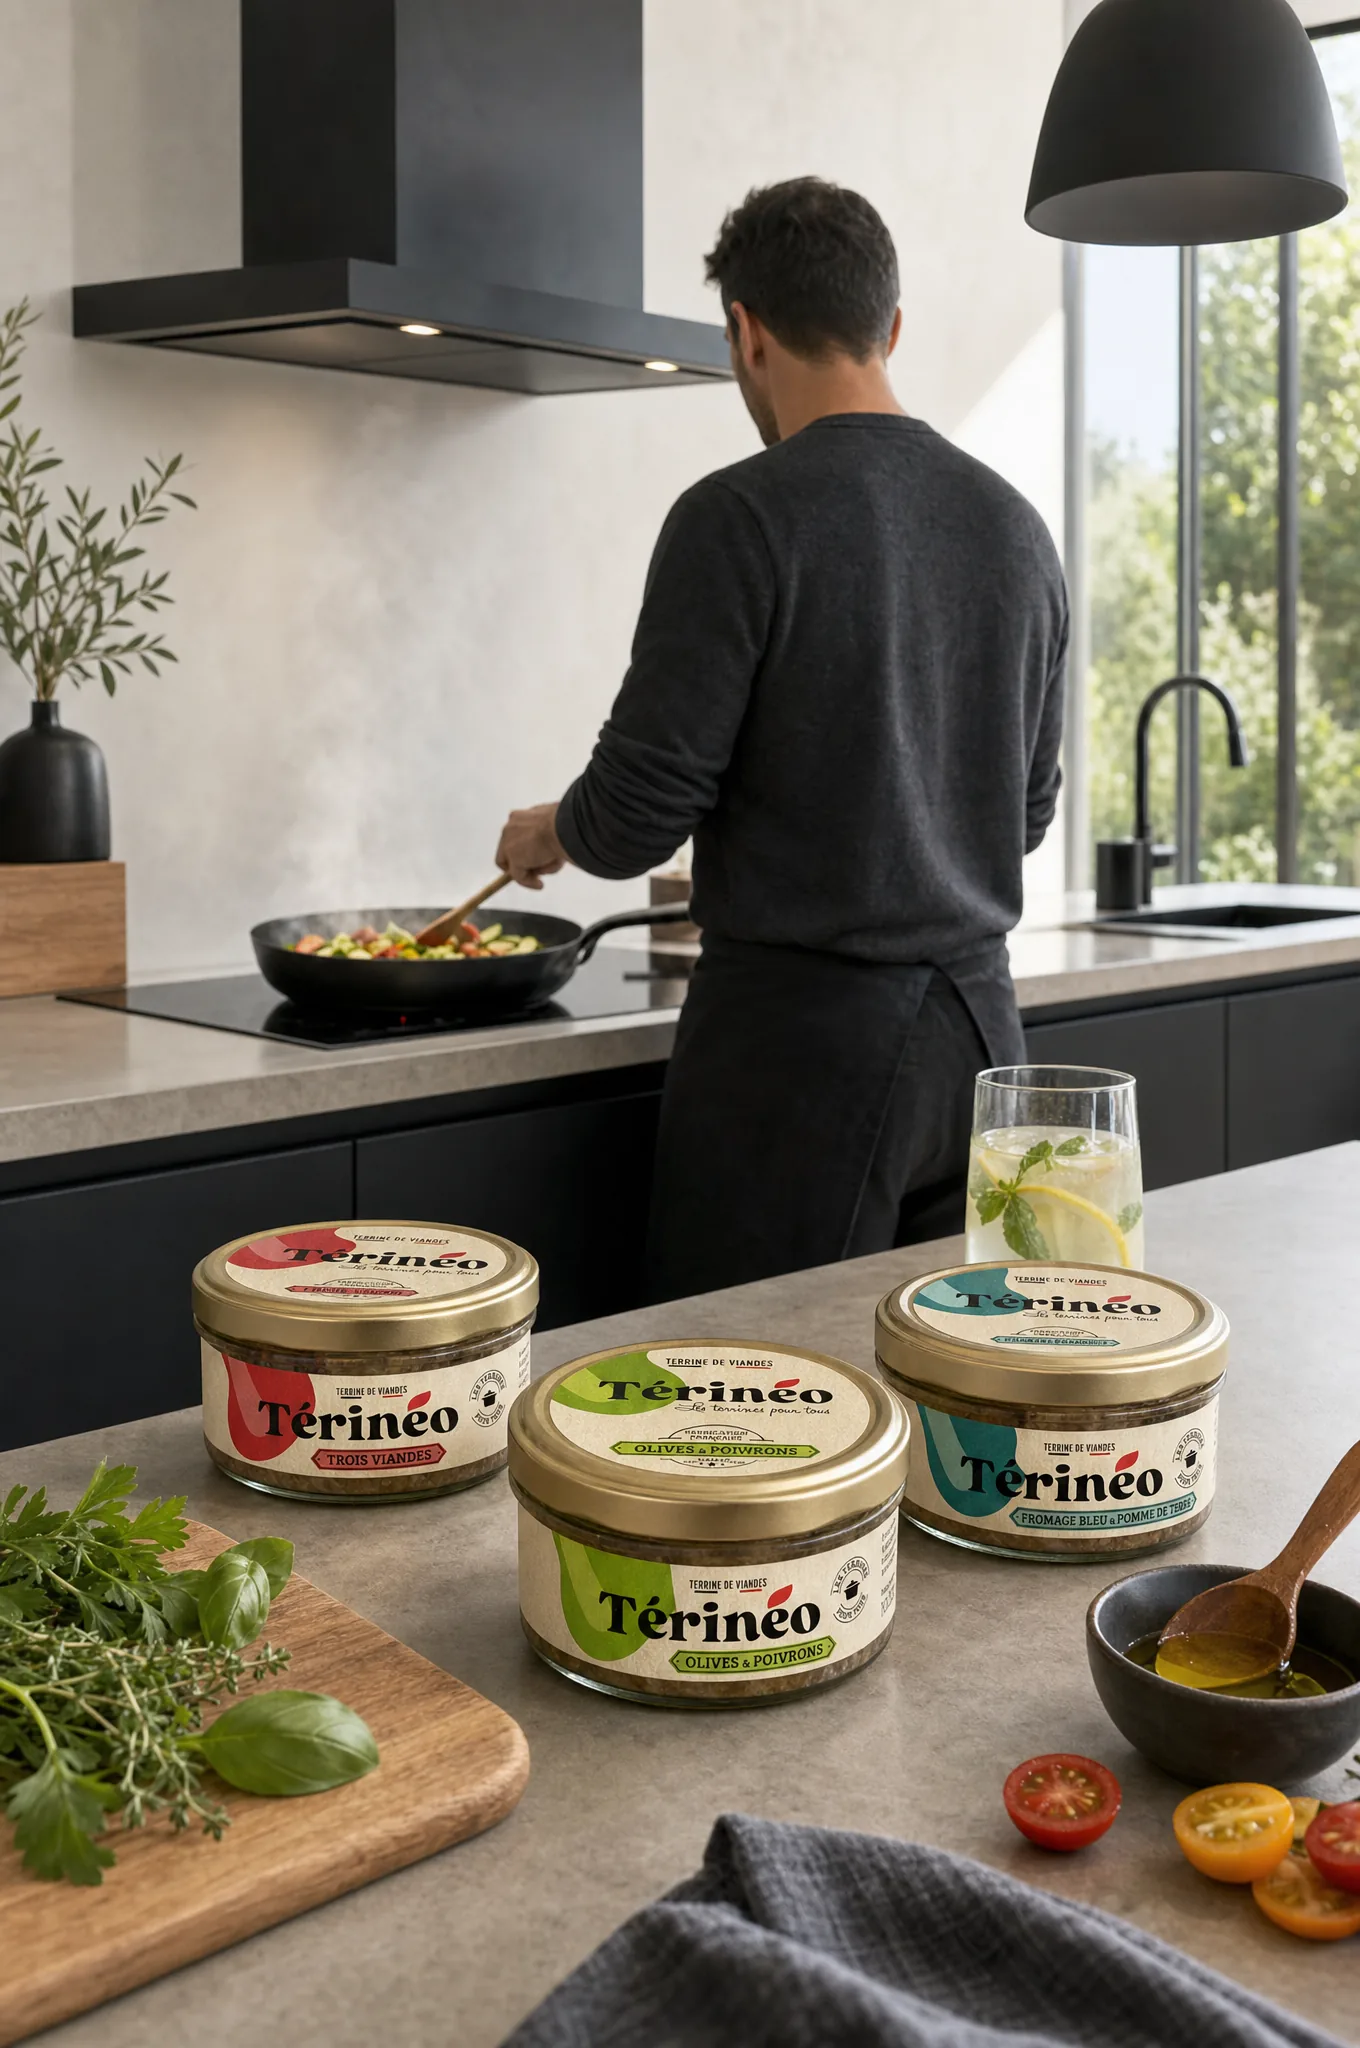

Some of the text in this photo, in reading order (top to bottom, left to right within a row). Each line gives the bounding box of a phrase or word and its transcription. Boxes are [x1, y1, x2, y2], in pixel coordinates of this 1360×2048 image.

[283, 1248, 489, 1270] Térinéo
[1068, 1278, 1108, 1286] VIANDES
[956, 1293, 1162, 1315] Térinéo
[665, 1357, 773, 1367] TERRINE DE VIANDES
[599, 1378, 834, 1405] Térinéo
[258, 1390, 459, 1441] Térinéo
[769, 1407, 801, 1417] pour
[803, 1405, 831, 1415] tous
[327, 1449, 432, 1466] TROIS VIANDES
[634, 1444, 695, 1454] OLIVES
[1043, 1442, 1116, 1453] TERRINE DE VIANDES
[960, 1450, 1163, 1502] Térinéo
[1021, 1512, 1077, 1526] FROMAGE
[1079, 1513, 1108, 1526] BLEU
[1117, 1508, 1155, 1525] POMME
[1156, 1505, 1168, 1518] DE
[689, 1577, 768, 1590] TERRINE DE VIANDES
[599, 1584, 821, 1643] Térinéo
[685, 1643, 824, 1669] OLIVES & POIVRONS
